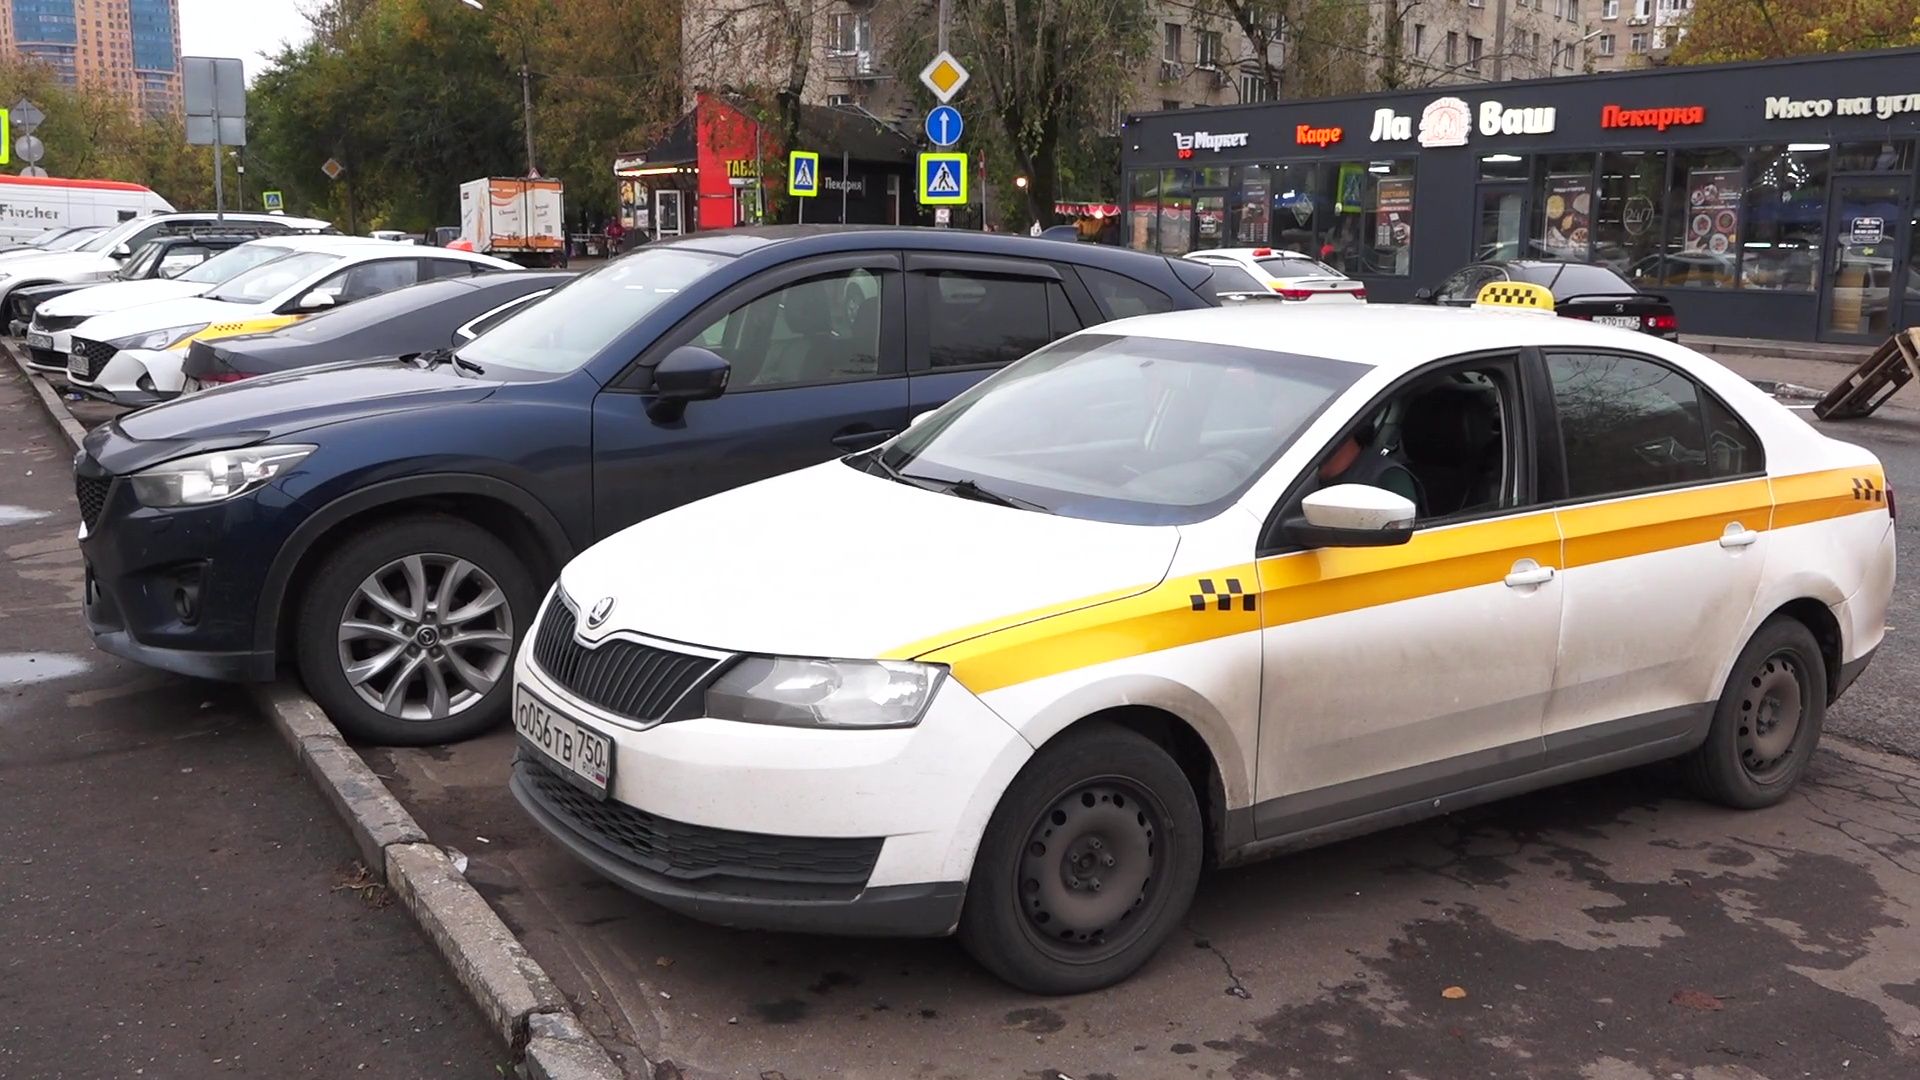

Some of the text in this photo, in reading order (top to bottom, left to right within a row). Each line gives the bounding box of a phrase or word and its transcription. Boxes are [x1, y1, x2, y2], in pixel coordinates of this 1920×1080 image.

[1601, 104, 1705, 131] Пекарня
[1765, 96, 1832, 120] Мясо
[1837, 97, 1872, 115] на
[1370, 100, 1556, 142] Ла Ваш
[1194, 131, 1249, 152] Маркет
[1296, 123, 1343, 148] Кафе
[0, 204, 60, 219] Fincher
